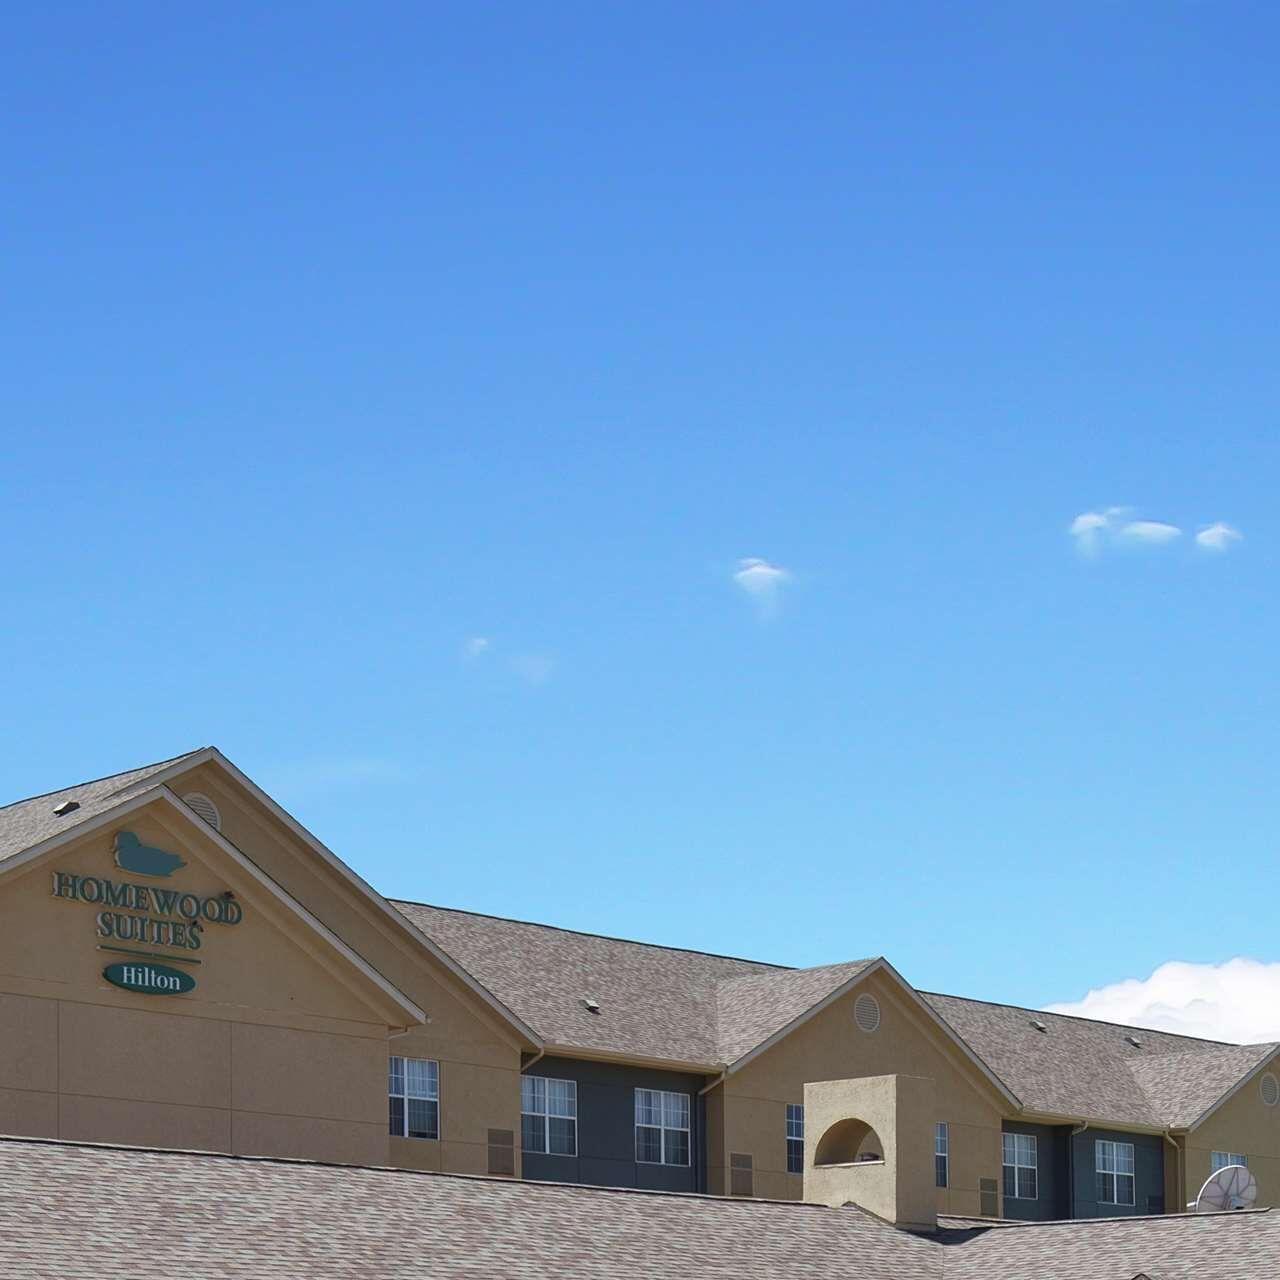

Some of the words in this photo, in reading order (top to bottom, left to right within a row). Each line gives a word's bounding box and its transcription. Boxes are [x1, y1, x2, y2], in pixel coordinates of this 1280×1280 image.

[52, 871, 243, 925] HOMEWOOD
[97, 911, 202, 949] SUITES
[122, 966, 181, 990] Hilton
